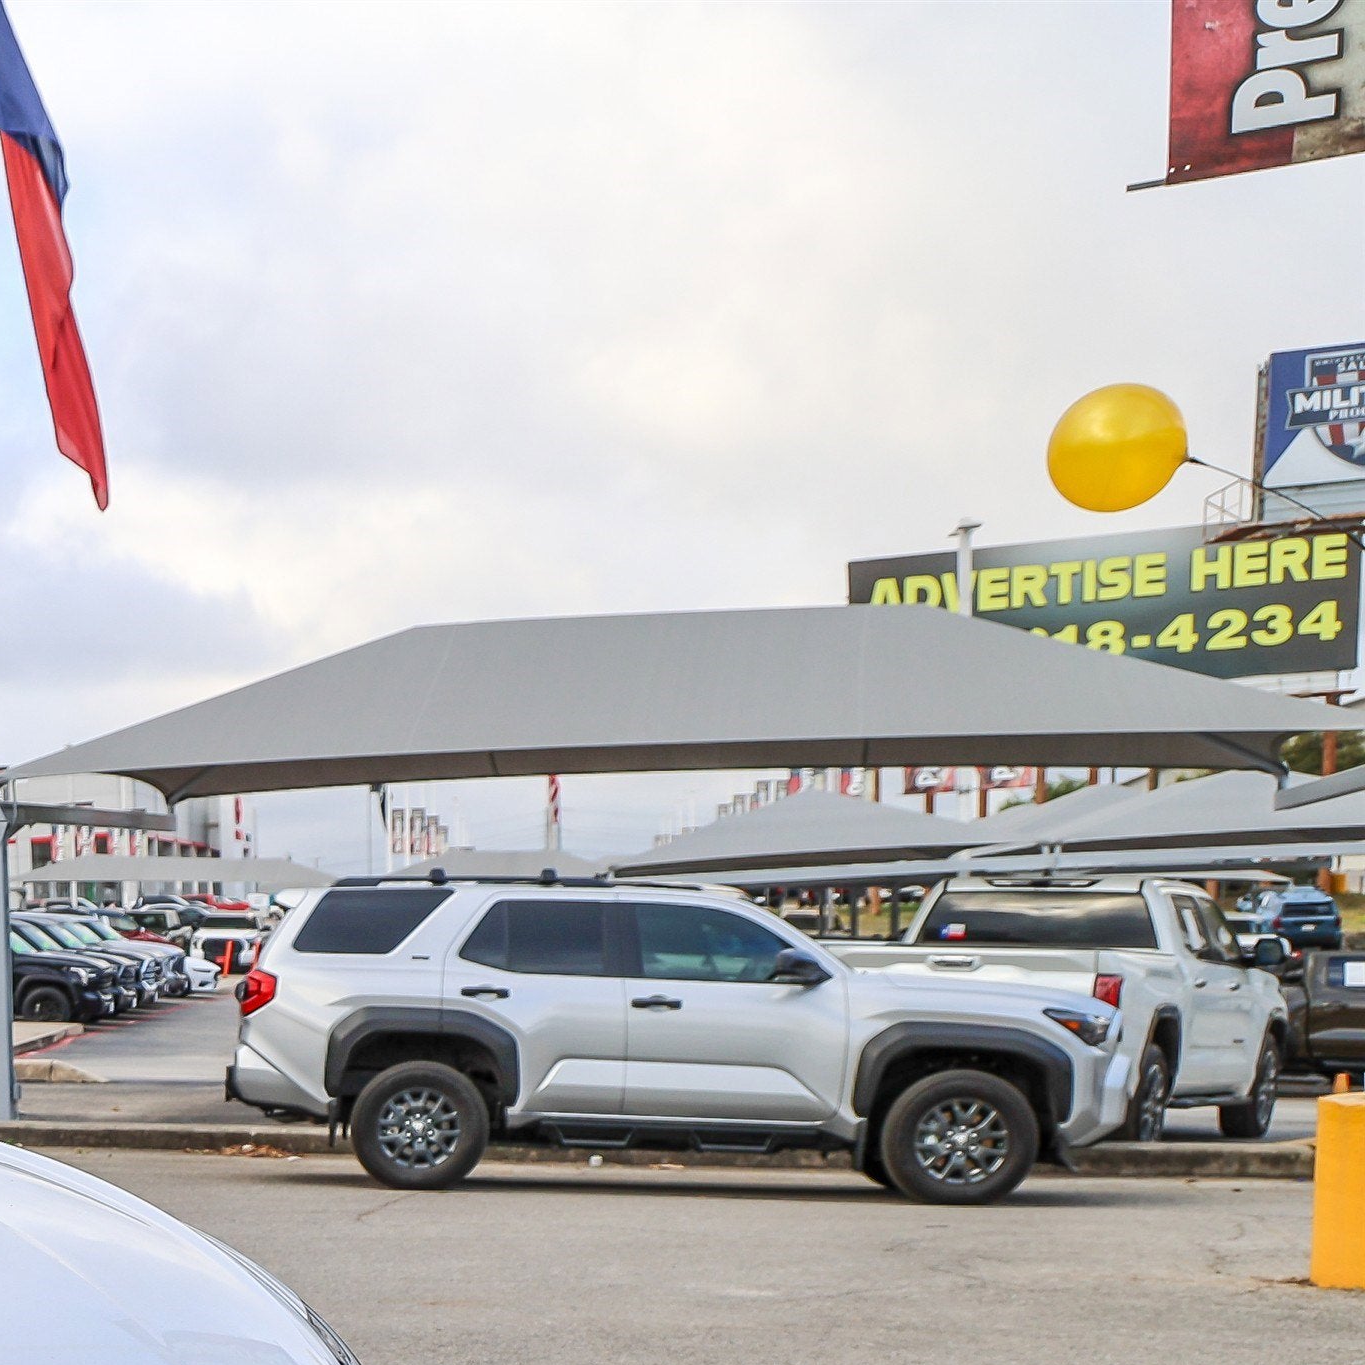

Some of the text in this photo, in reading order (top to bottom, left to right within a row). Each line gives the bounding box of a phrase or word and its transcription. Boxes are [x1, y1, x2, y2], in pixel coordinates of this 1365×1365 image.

[870, 533, 1349, 614] ADVERTISE HERE
[1030, 600, 1343, 656] 18-4234
